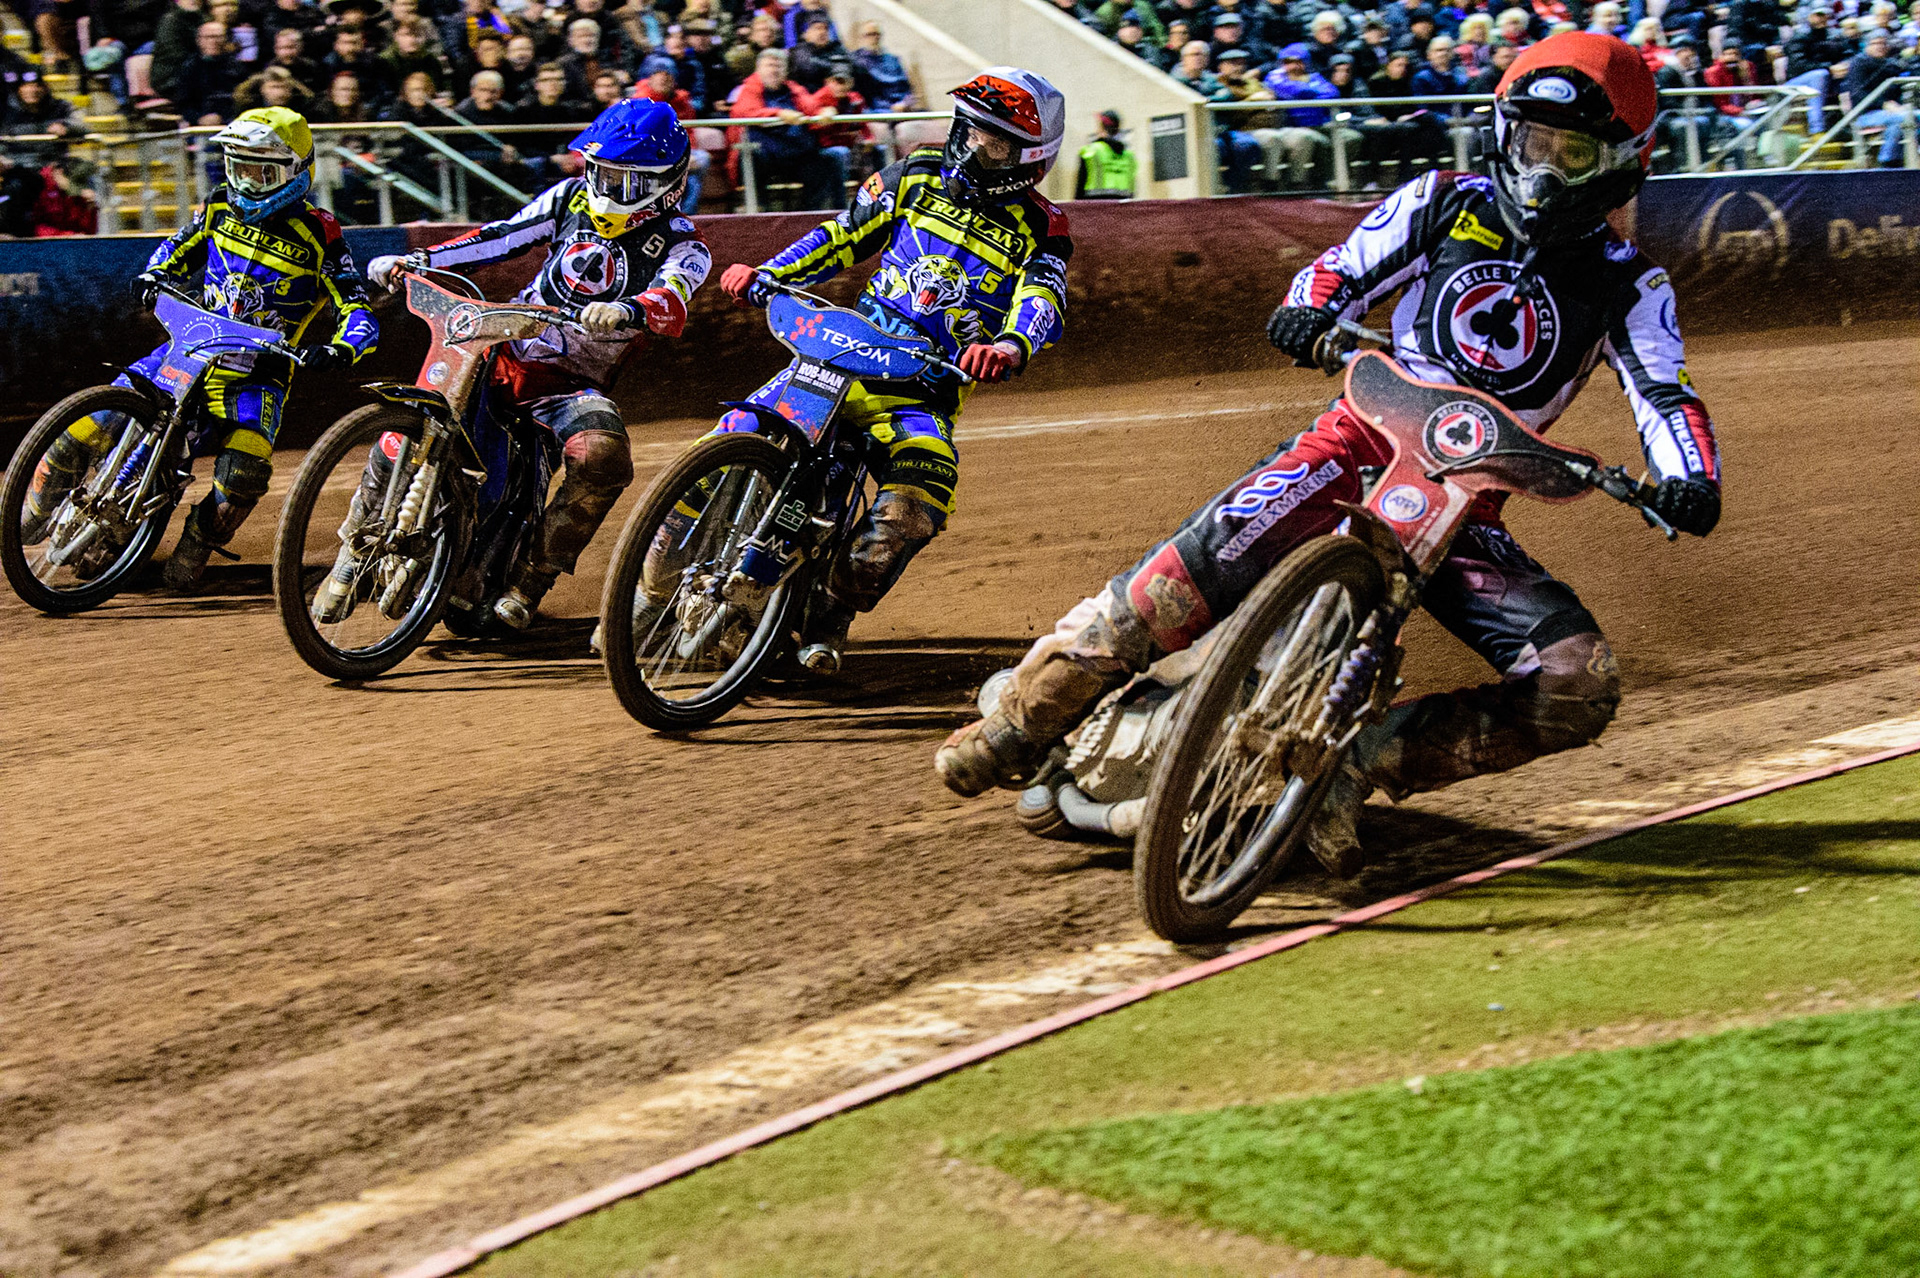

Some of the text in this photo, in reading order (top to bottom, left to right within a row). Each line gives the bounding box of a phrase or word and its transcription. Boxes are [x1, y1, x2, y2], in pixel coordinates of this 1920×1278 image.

[922, 194, 961, 219] TRU
[221, 221, 306, 259] TRU PLANT
[276, 280, 292, 296] 3
[979, 270, 1003, 294] 5
[1452, 267, 1502, 294] BELLE
[1535, 298, 1553, 340] ACES
[822, 327, 891, 367] TEXOM
[749, 368, 794, 405] TEXO
[797, 361, 846, 389] ROB-MAN
